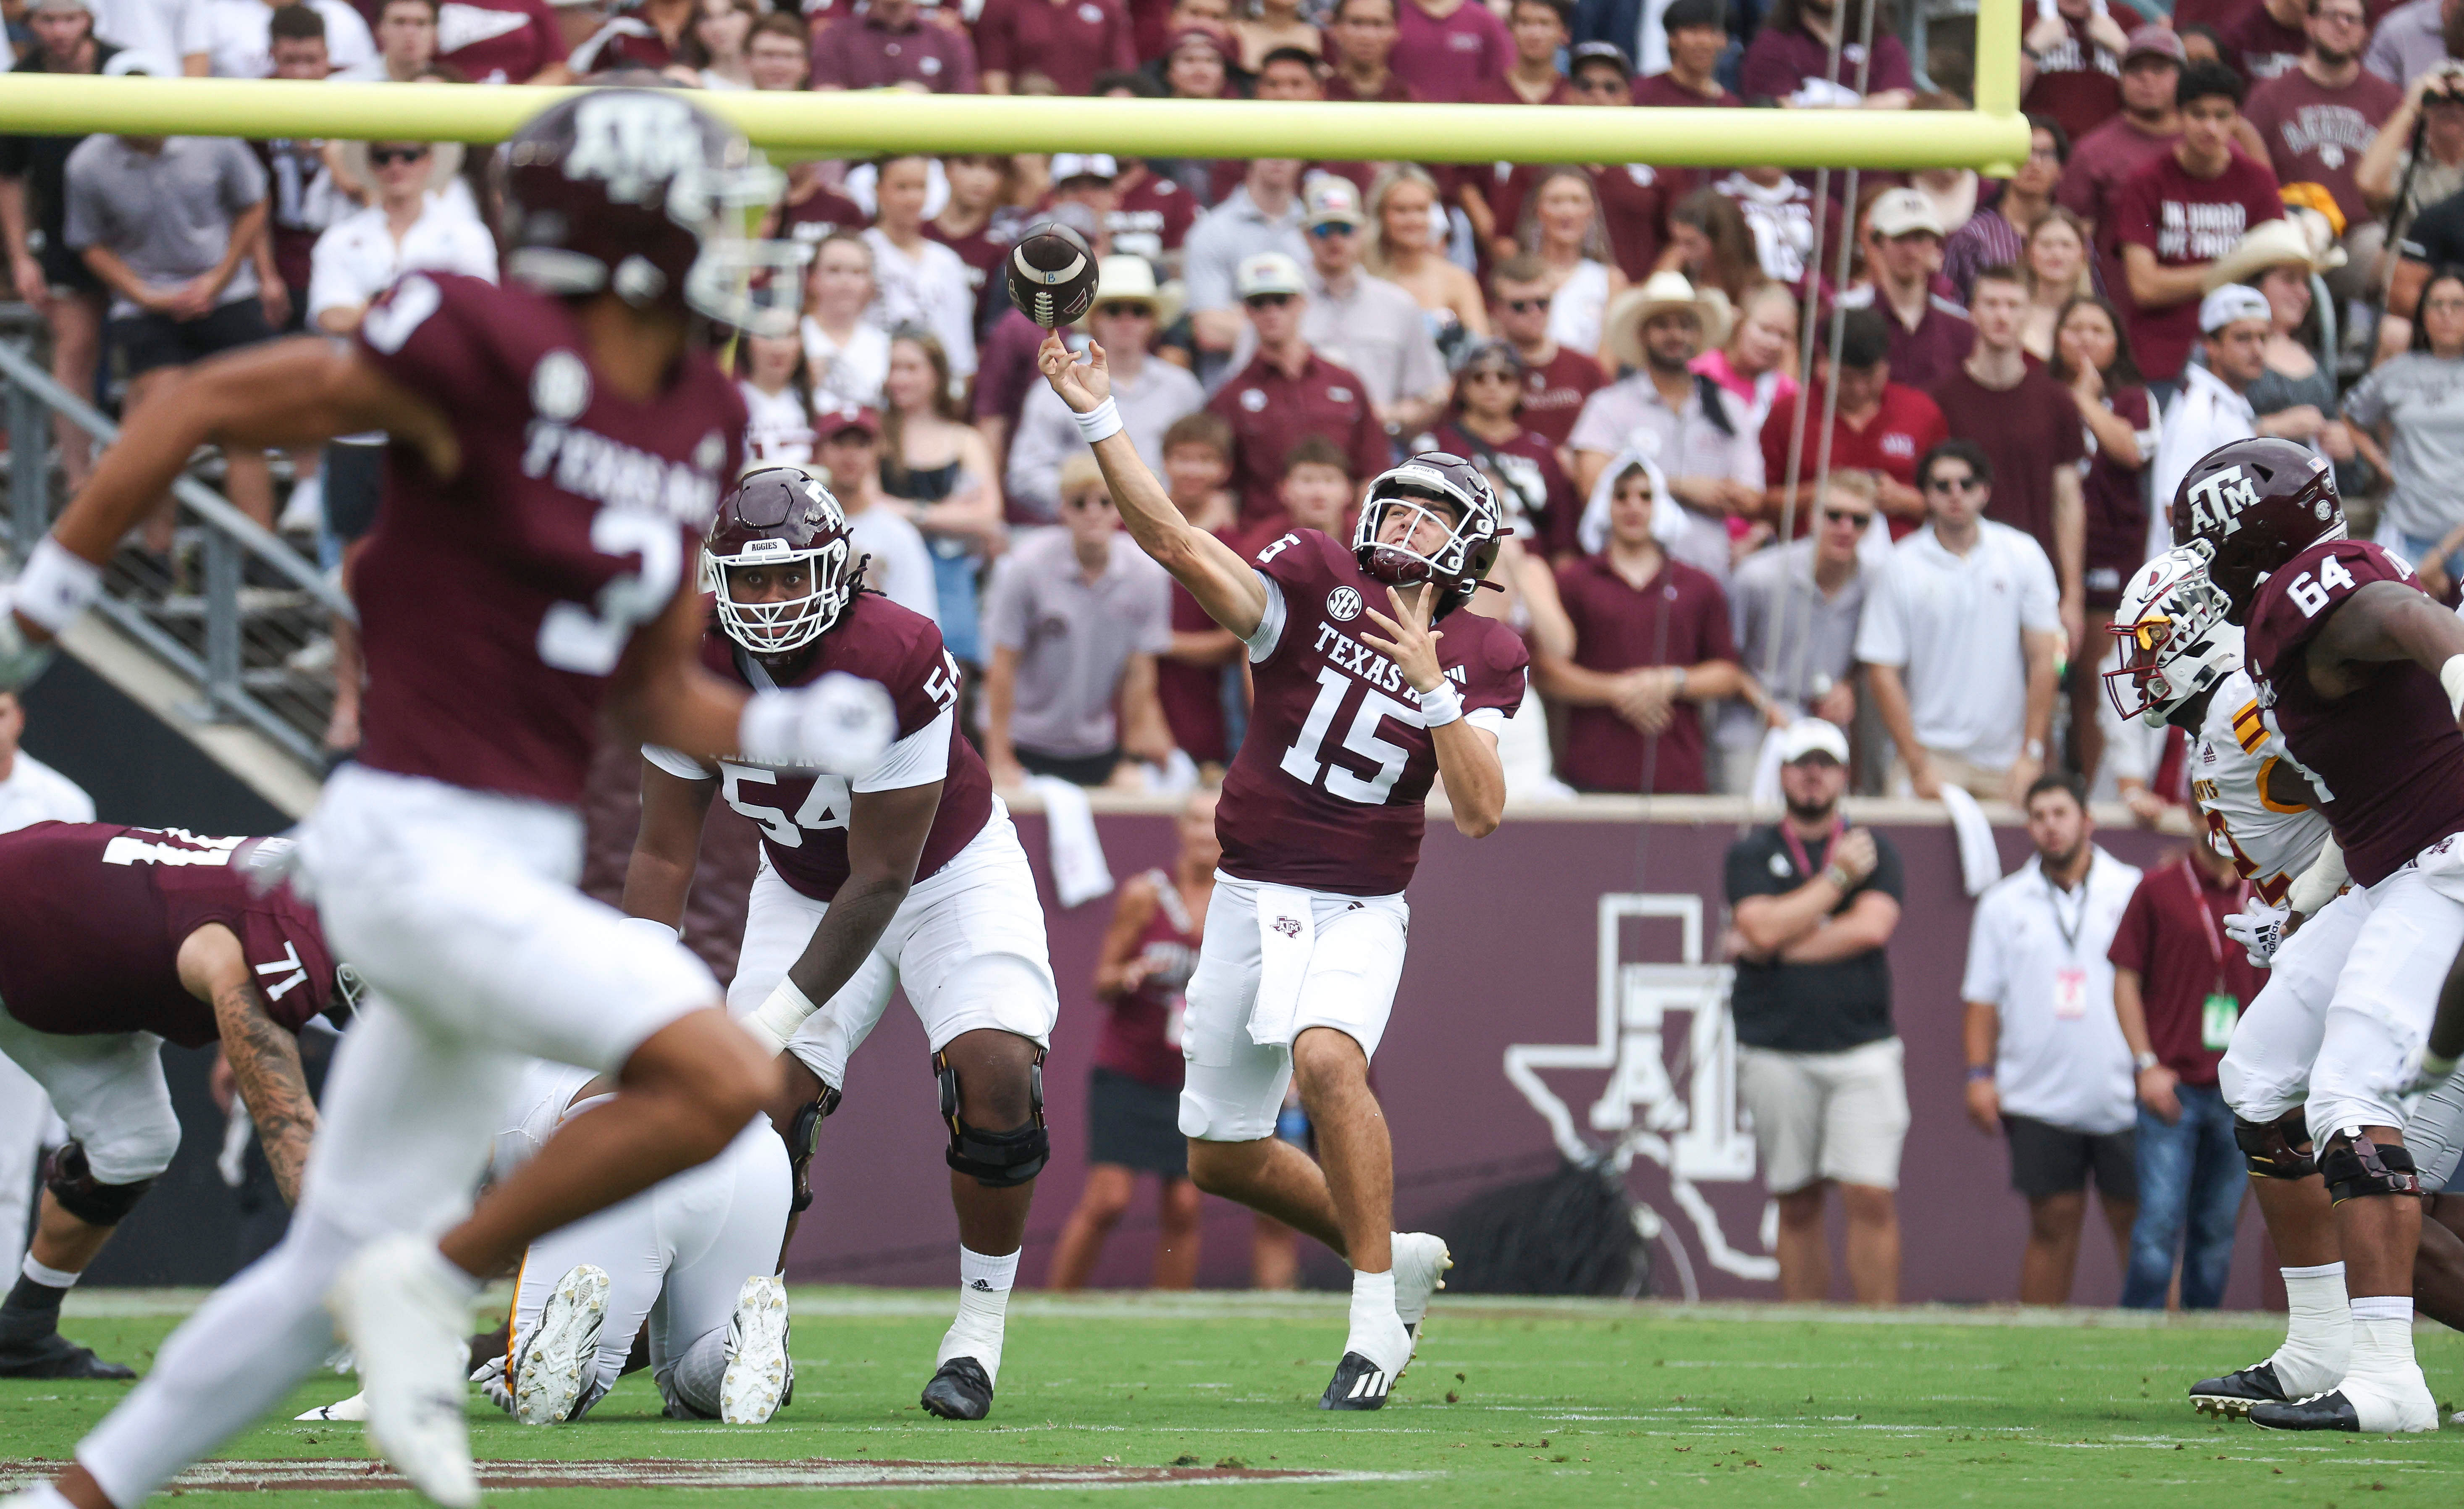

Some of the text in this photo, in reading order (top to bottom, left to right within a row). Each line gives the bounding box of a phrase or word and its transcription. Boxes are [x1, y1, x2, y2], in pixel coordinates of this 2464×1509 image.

[752, 541, 777, 551] AGGIES
[1329, 588, 1360, 619] SEC
[2286, 554, 2357, 619] 64
[1314, 621, 1404, 693] TEXAS
[1279, 665, 1427, 805] 15
[716, 761, 852, 848] 54
[255, 940, 309, 1002] 71
